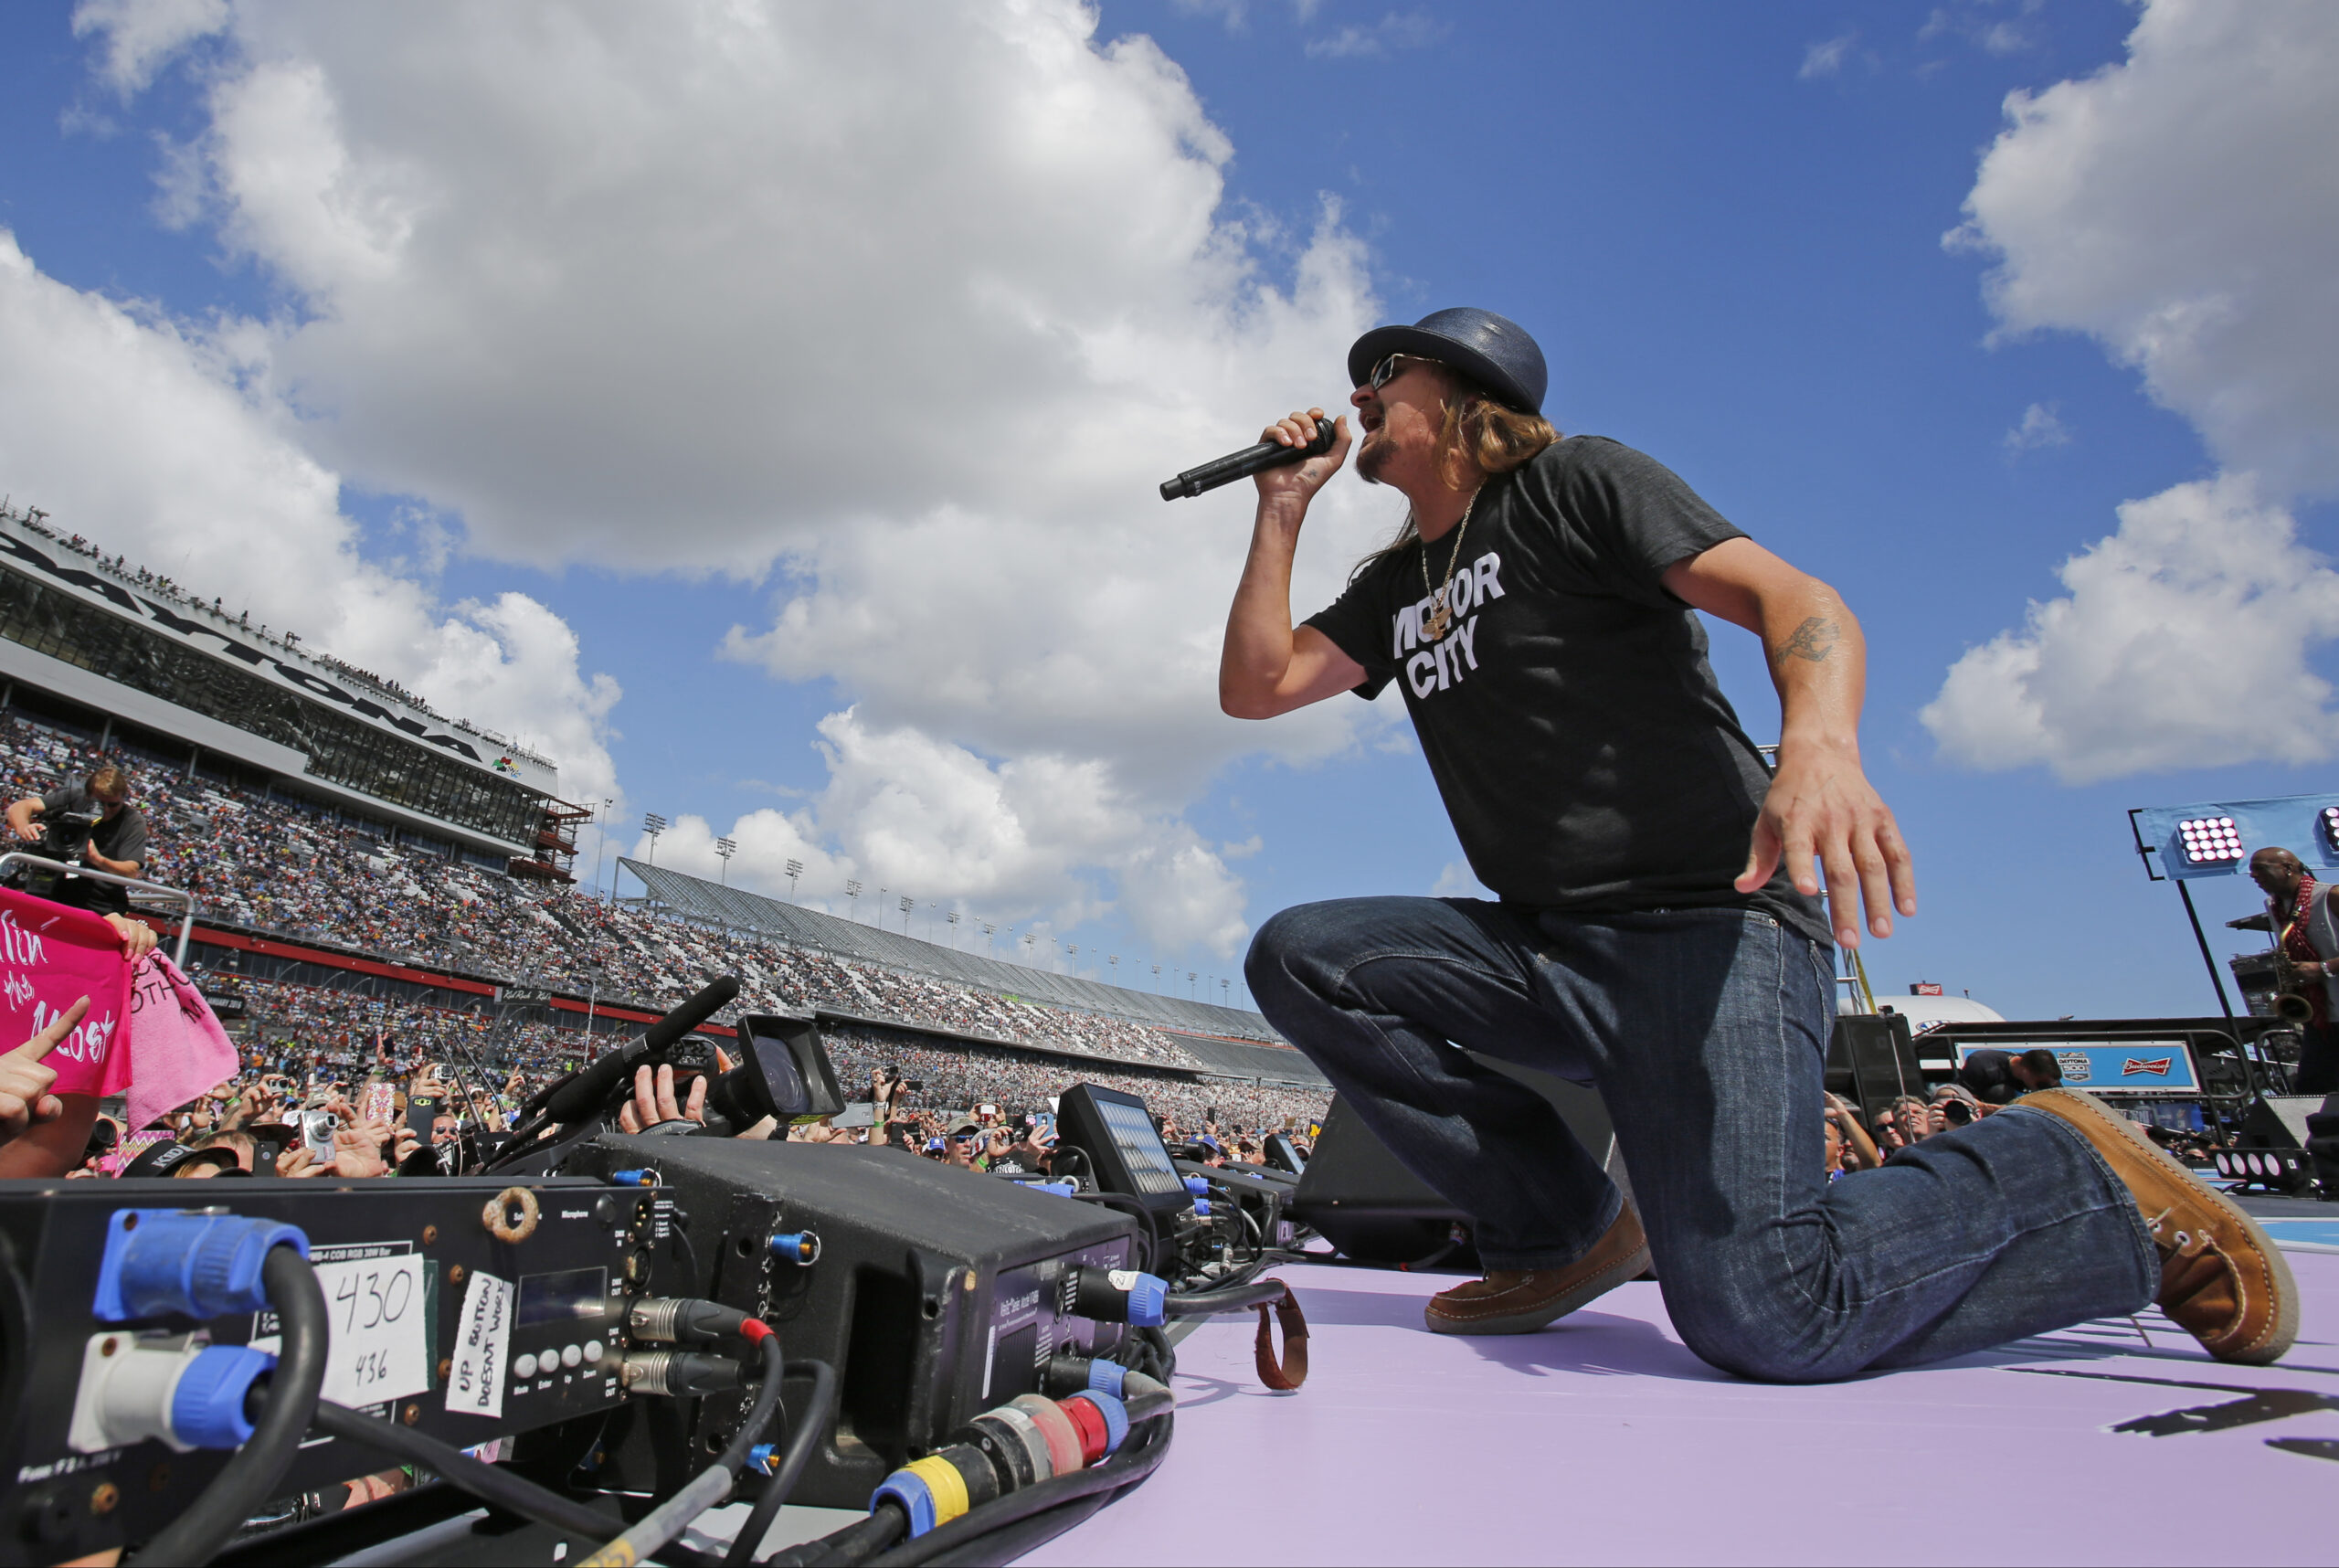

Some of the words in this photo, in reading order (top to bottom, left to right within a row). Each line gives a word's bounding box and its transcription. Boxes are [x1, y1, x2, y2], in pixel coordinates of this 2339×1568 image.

[1392, 551, 1506, 660] MOTOR
[1406, 614, 1479, 700] CITY
[2124, 1060, 2170, 1071] Budweiser
[336, 1269, 412, 1334] 430
[489, 1280, 505, 1332] WORK
[459, 1360, 473, 1393] UP
[468, 1277, 492, 1347] BUTTON
[355, 1348, 387, 1387] 436
[537, 1380, 553, 1391] Enter
